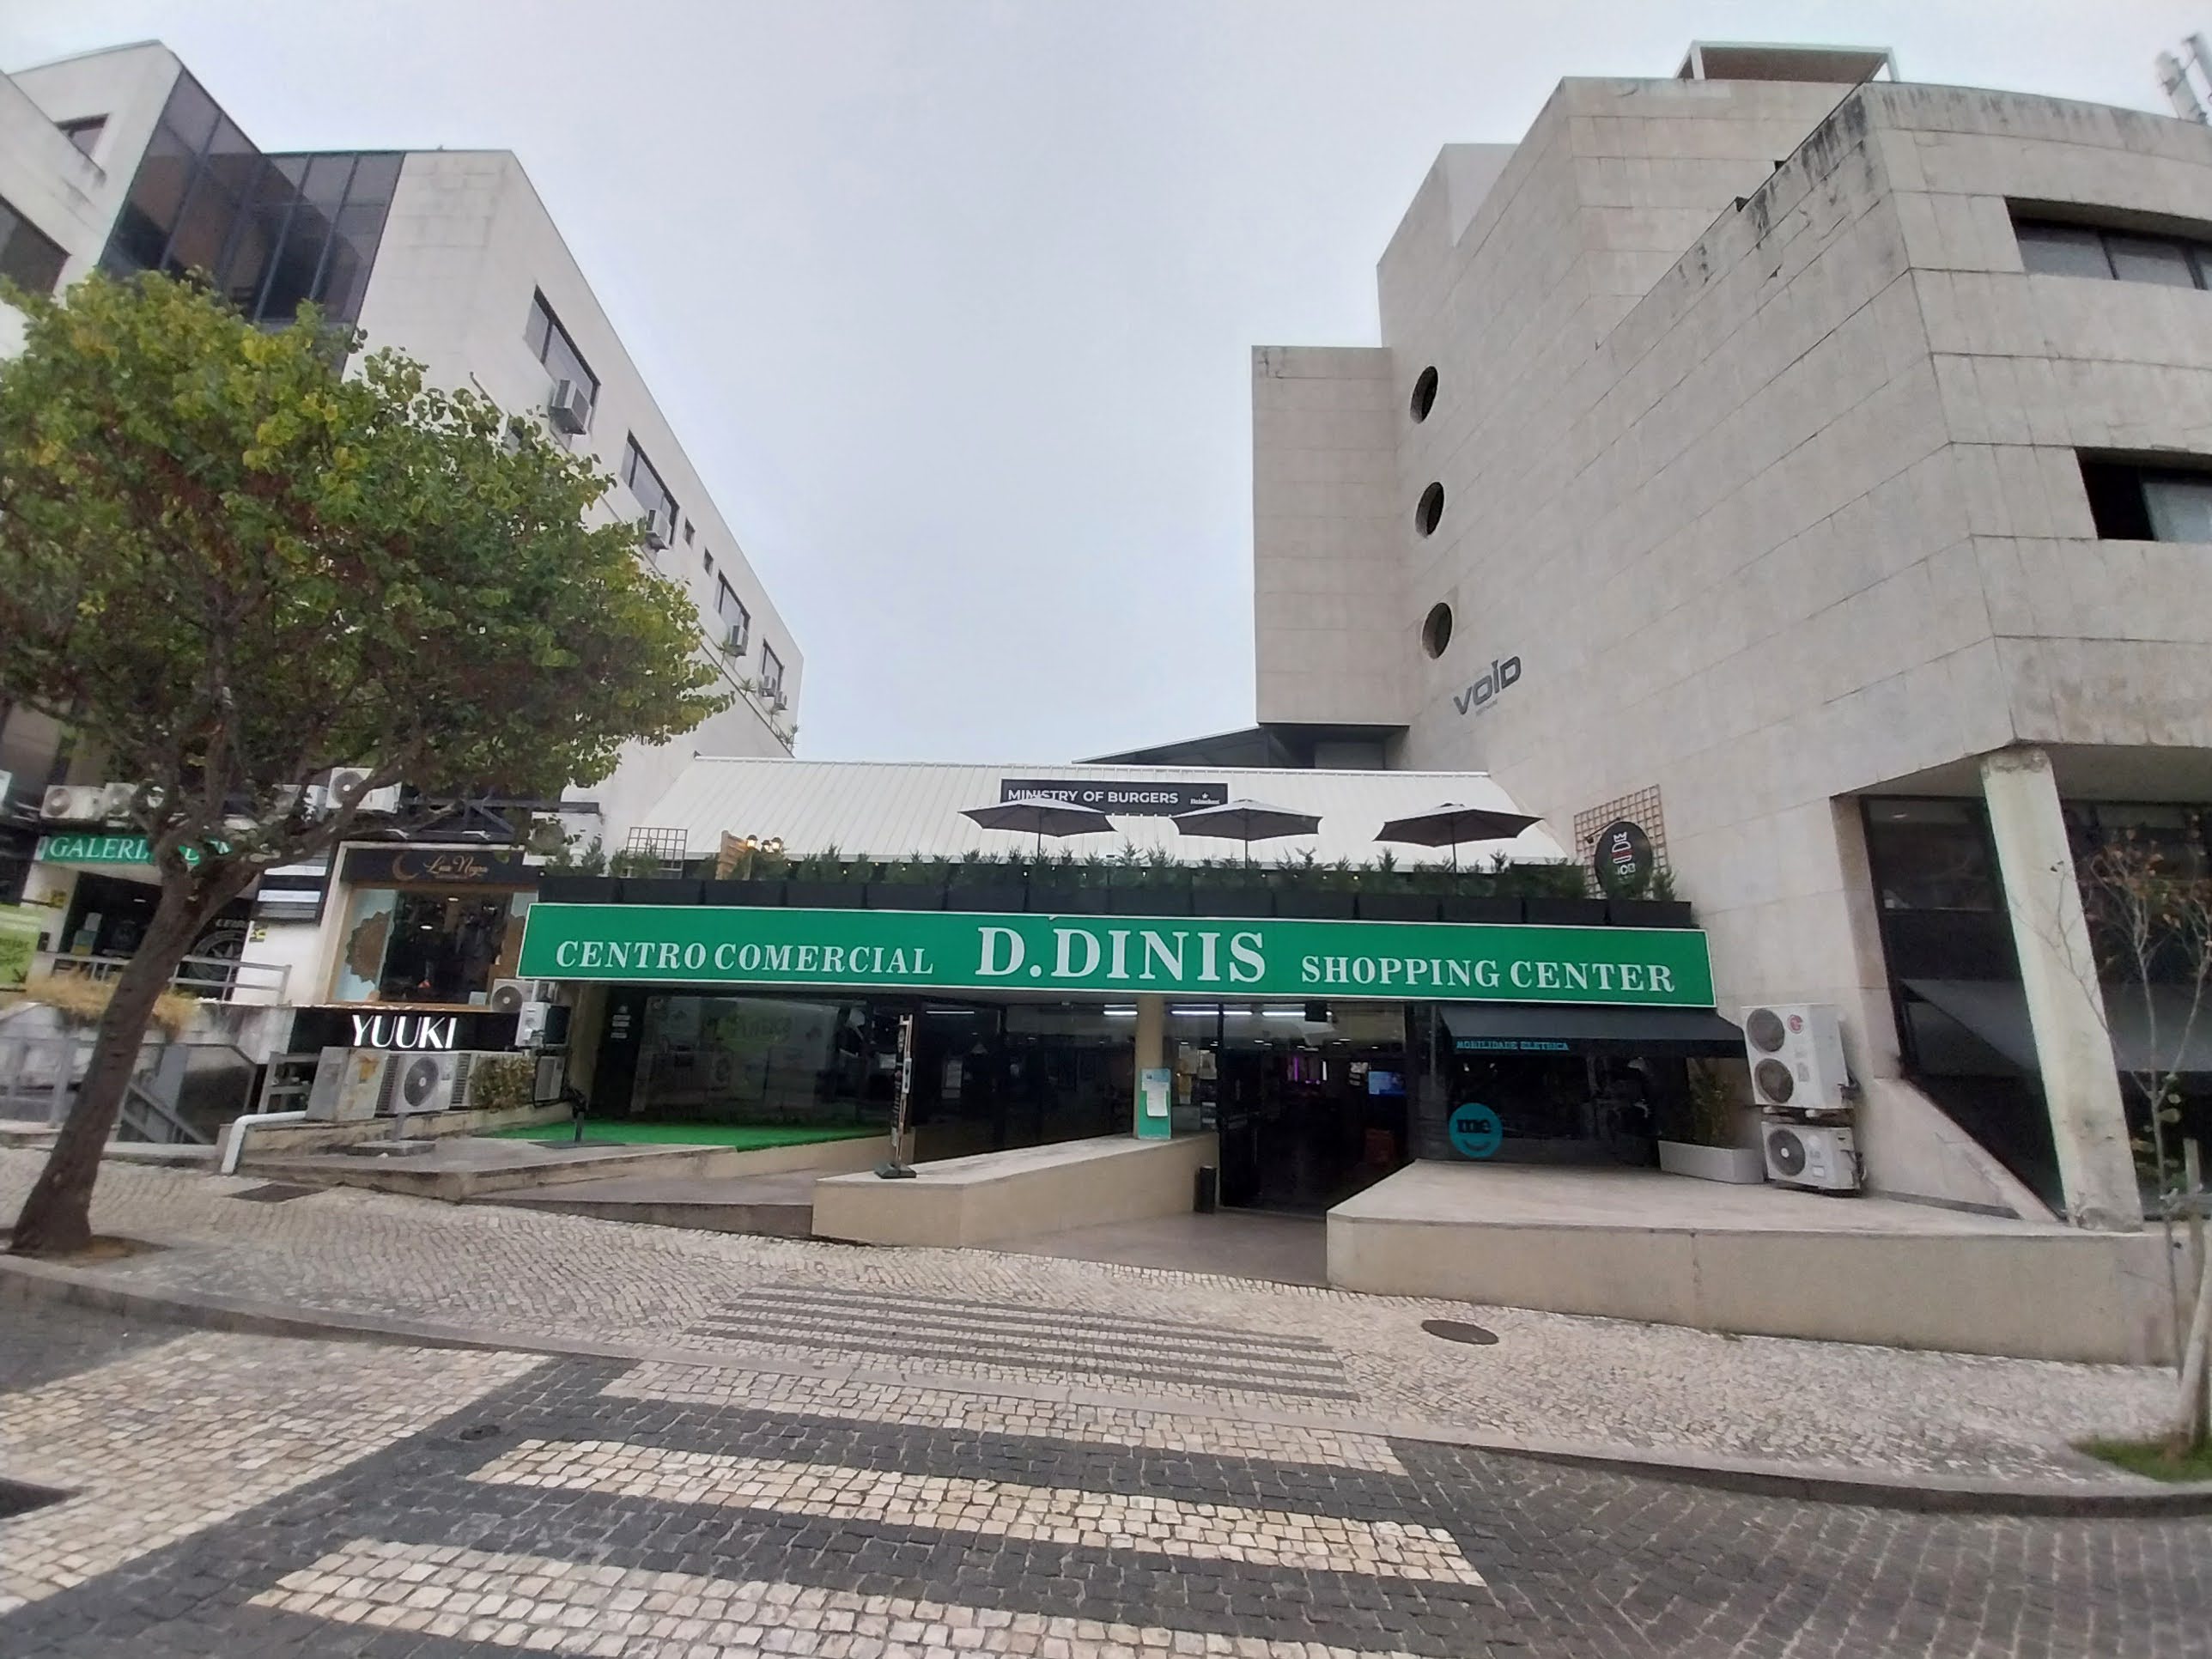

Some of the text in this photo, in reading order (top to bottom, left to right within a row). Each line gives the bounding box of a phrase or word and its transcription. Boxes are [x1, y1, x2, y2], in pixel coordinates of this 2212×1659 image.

[1083, 789, 1104, 803] OF
[1107, 790, 1179, 805] BURGERS
[49, 836, 151, 860] GALERI
[556, 926, 1675, 993] CENTRO COMERCIAL D.DINIS SHOPPING CENTER
[352, 1014, 458, 1048] YUUKI
